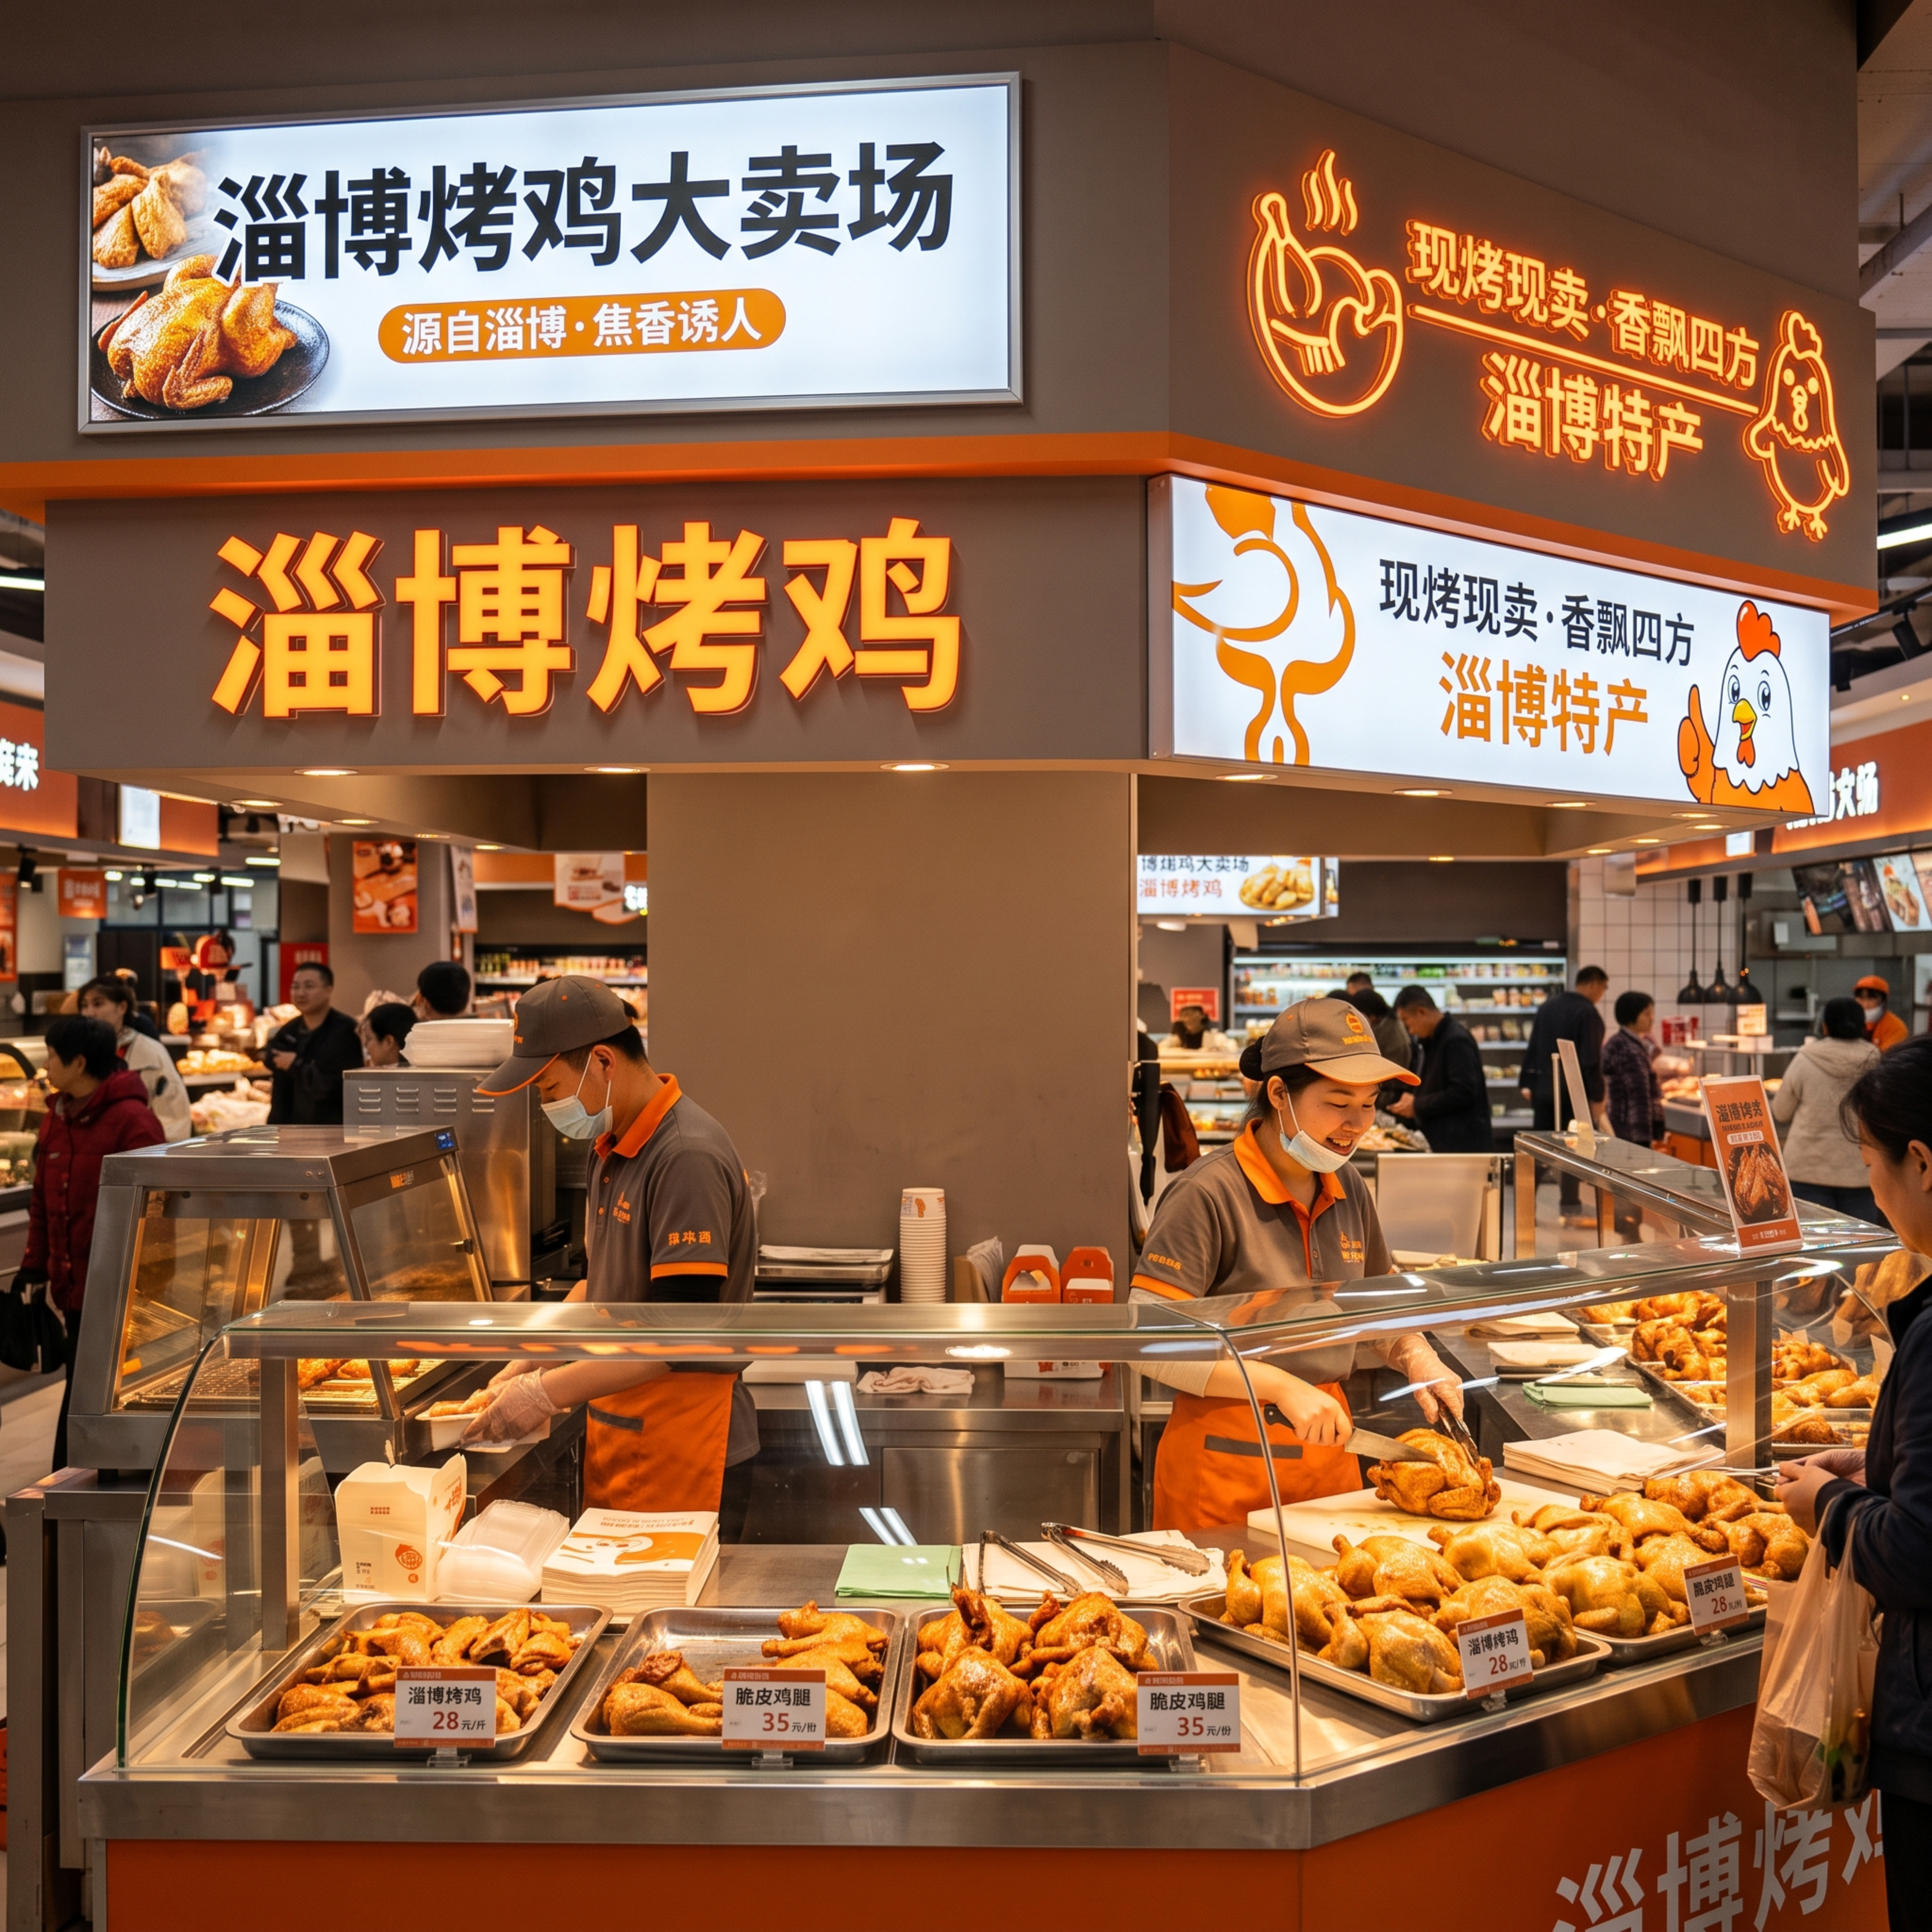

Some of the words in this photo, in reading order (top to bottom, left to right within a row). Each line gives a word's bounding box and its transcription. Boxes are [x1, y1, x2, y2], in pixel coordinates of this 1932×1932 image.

[212, 141, 953, 283] 淄博烤鸡大卖场
[402, 297, 762, 355] 源自淄博·焦香诱人
[1406, 219, 1759, 389] 现烤现卖·香飘四方
[1480, 352, 1703, 480] 淄博特产
[208, 516, 961, 718] 淄博烤鸡
[1379, 558, 1695, 666] 现烤现卖·香飘四方
[1438, 651, 1649, 757] 淄博特产
[1139, 878, 1222, 897] 淄博烤鸡
[408, 1686, 482, 1705] 淄博烤鸡
[735, 1687, 811, 1707] 脆皮鸡腿
[1150, 1692, 1225, 1711] 脆皮鸡腿
